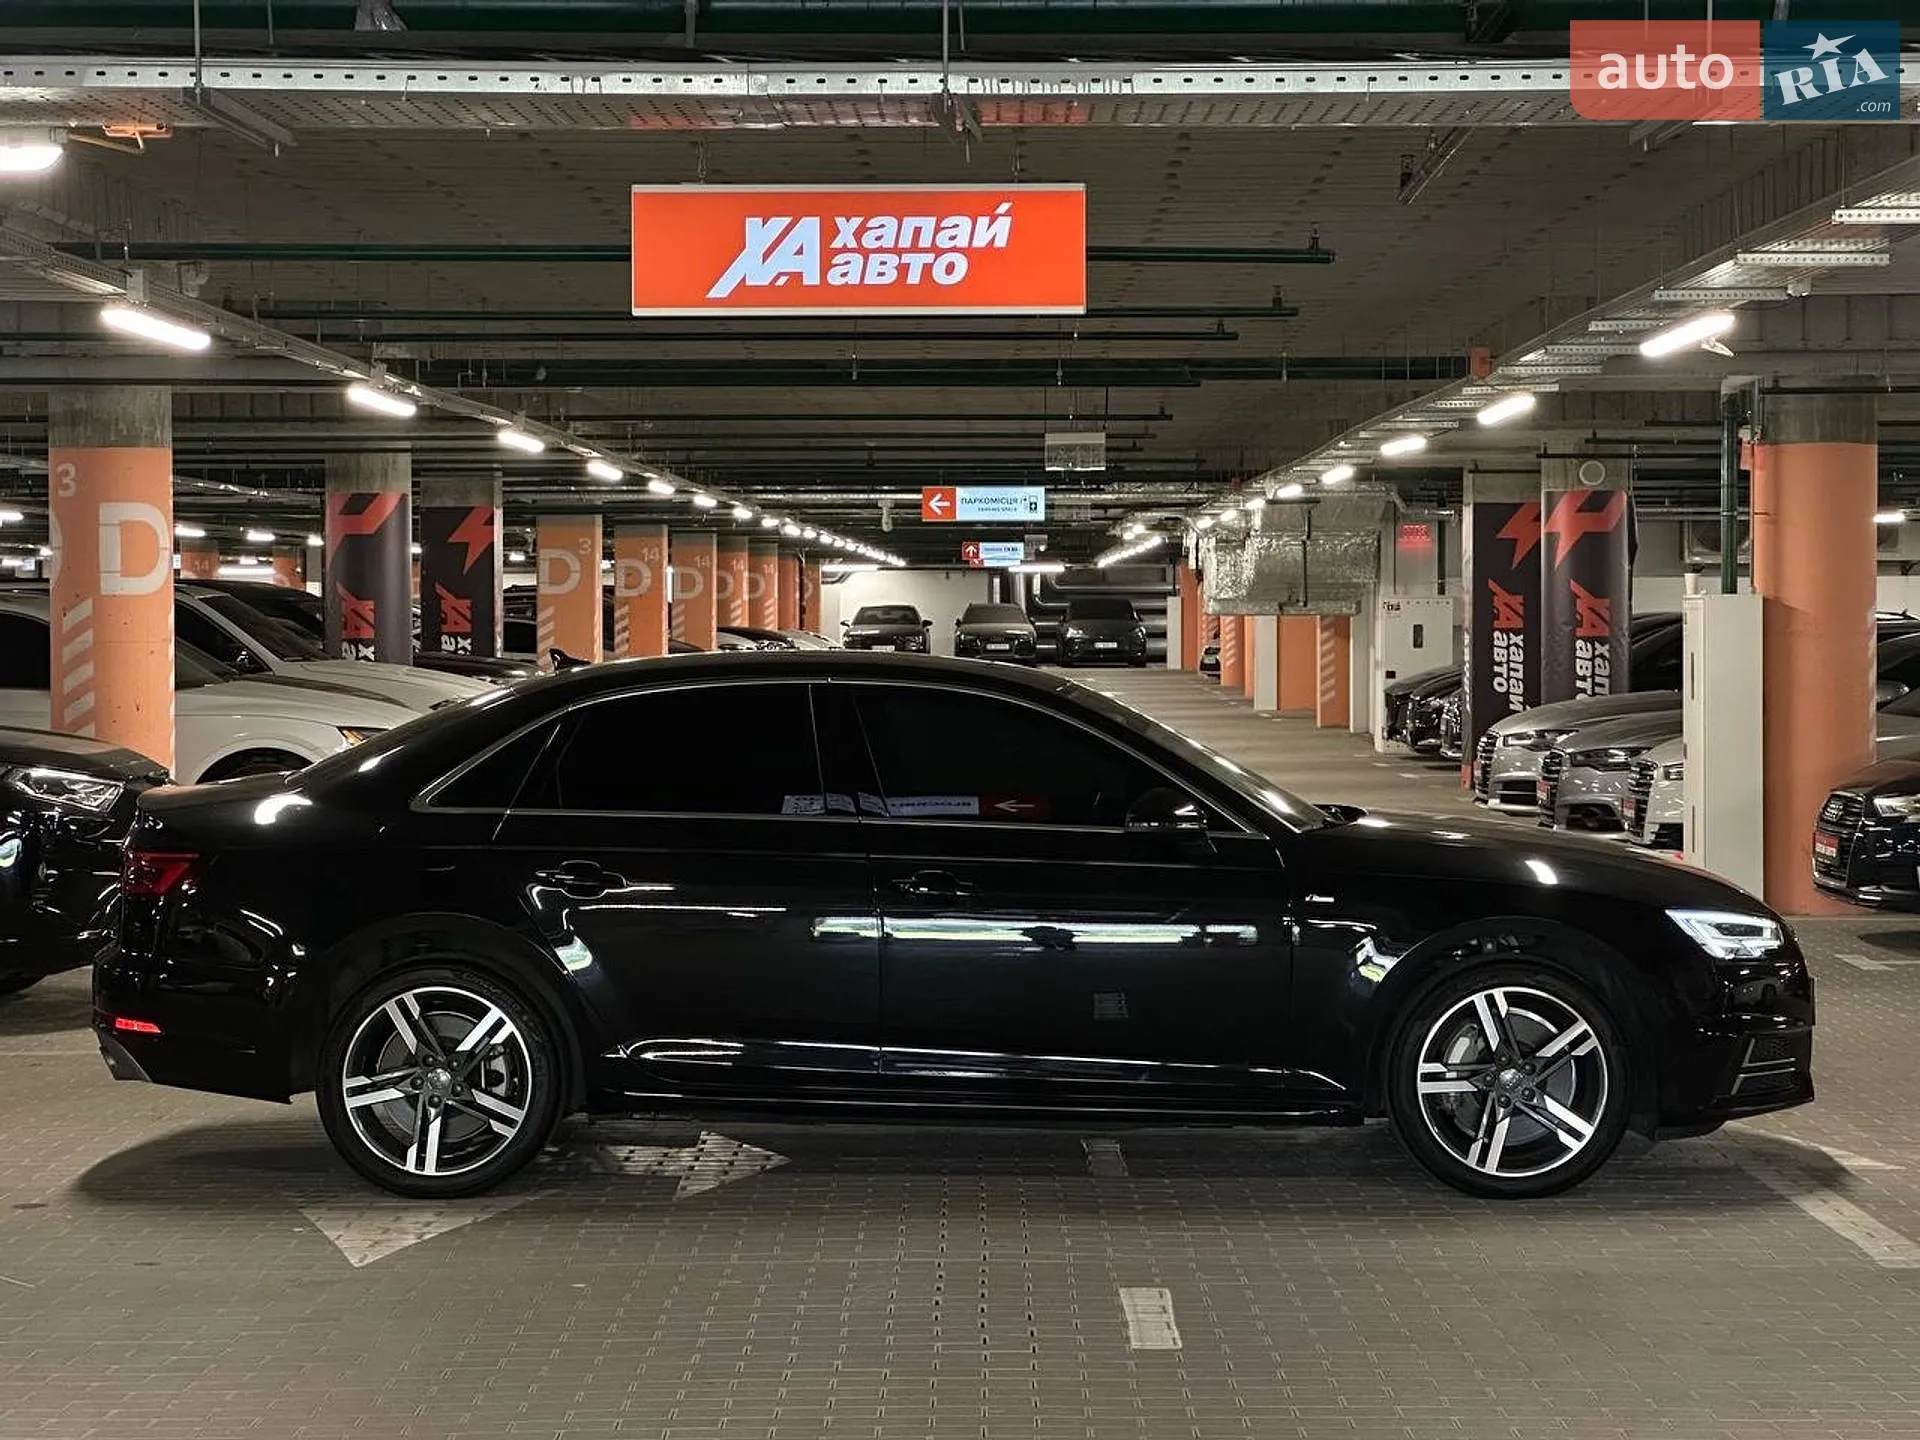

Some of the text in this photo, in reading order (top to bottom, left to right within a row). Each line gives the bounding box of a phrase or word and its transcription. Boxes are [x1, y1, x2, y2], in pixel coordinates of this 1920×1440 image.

[830, 201, 1013, 248] хапай
[827, 250, 969, 285] авто
[56, 463, 77, 498] 3
[98, 502, 171, 596] D
[539, 549, 581, 595] D
[616, 558, 652, 597] D
[673, 566, 704, 599] D
[1493, 631, 1509, 693] авто
[1593, 640, 1611, 696] хап
